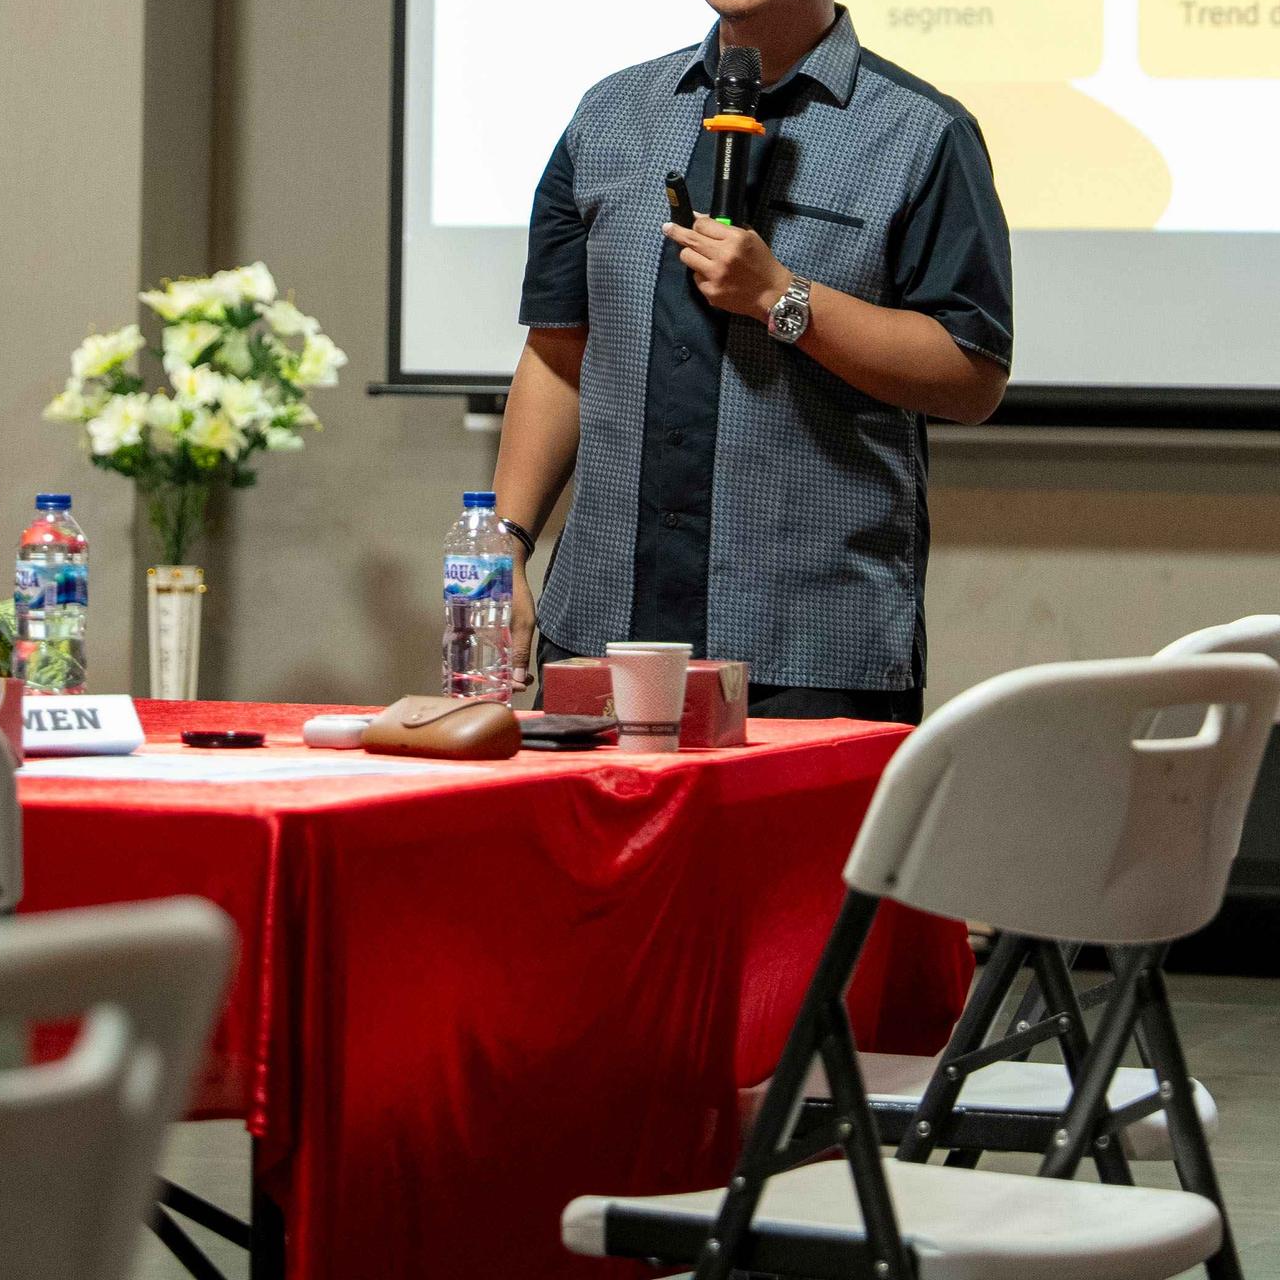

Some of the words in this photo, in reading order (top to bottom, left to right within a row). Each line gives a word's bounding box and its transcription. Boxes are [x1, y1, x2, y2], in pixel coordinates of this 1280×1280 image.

[887, 6, 993, 32] segmen
[1181, 1, 1259, 26] Trend
[722, 137, 734, 180] MICROVOICE
